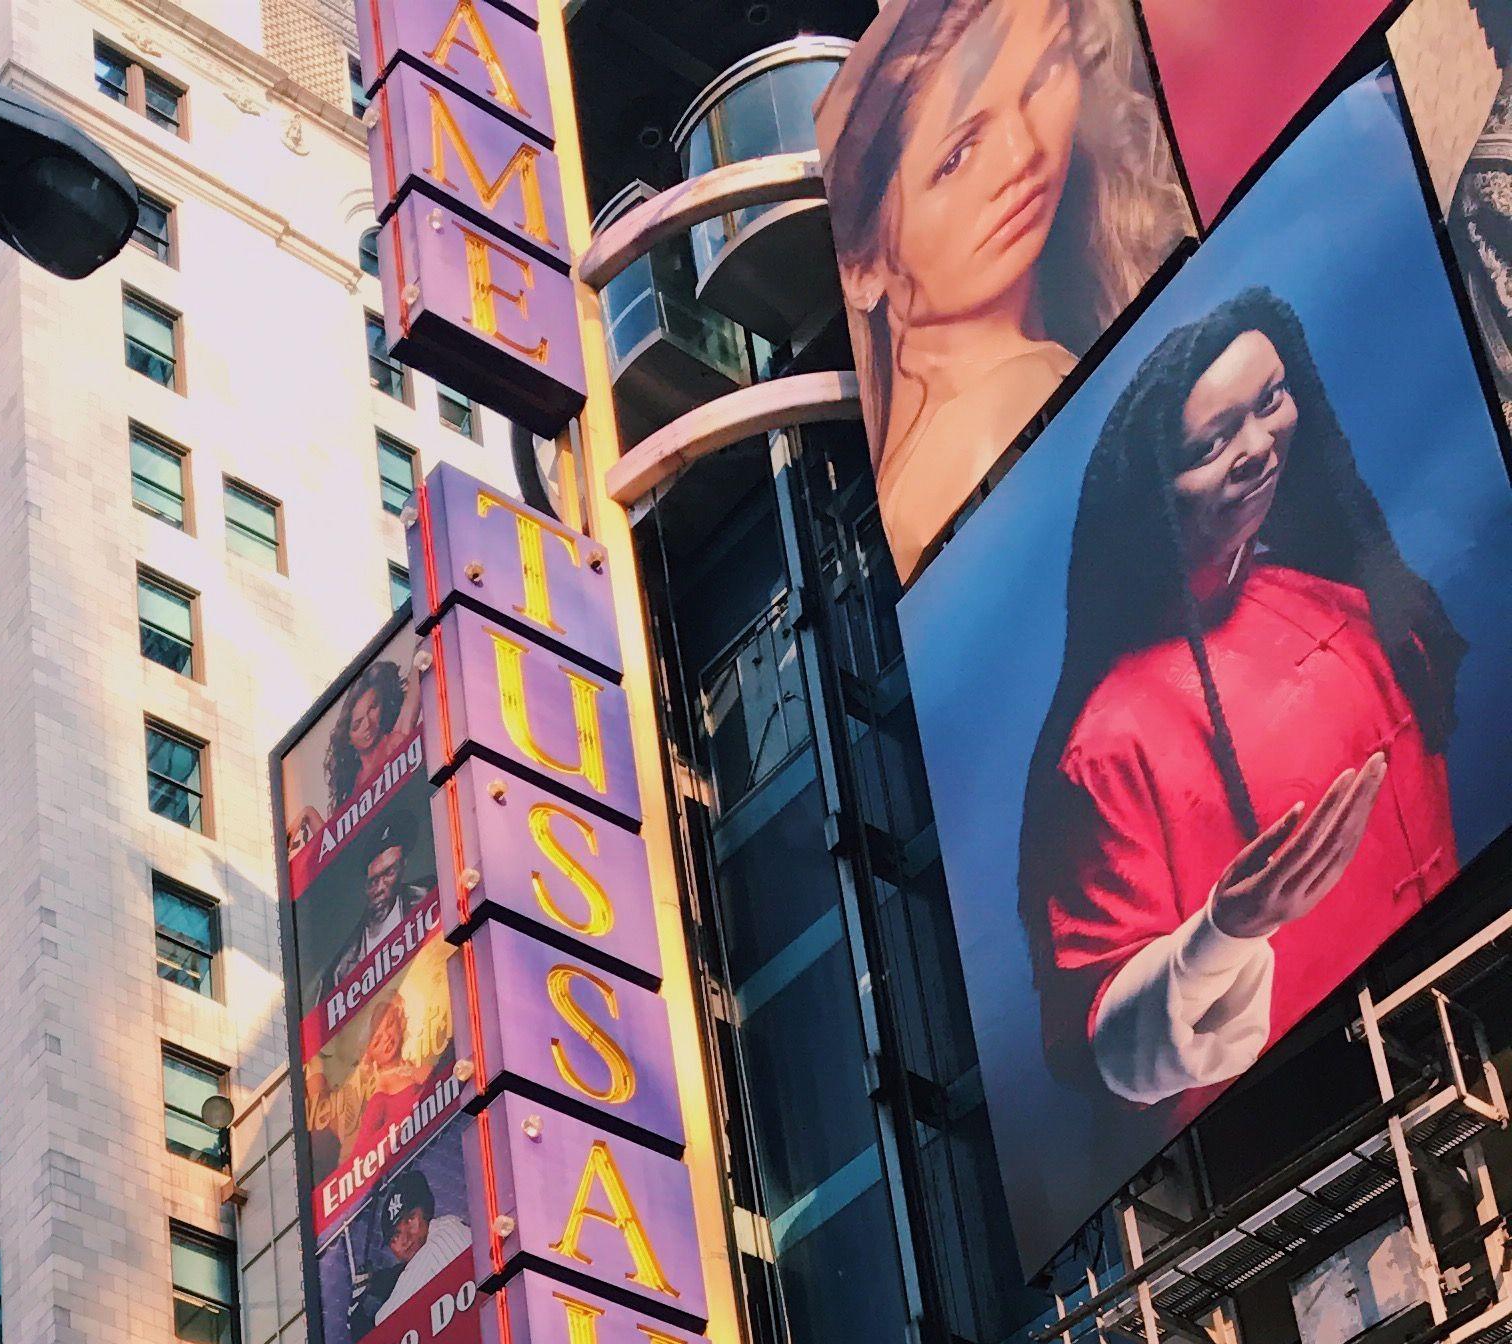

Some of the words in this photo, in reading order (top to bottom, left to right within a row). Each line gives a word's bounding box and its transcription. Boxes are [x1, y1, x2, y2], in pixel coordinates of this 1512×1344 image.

[318, 735, 423, 864] Amazing
[326, 899, 442, 1032] Realistic
[321, 1074, 461, 1219] Entertainin
[430, 1278, 478, 1340] Do
